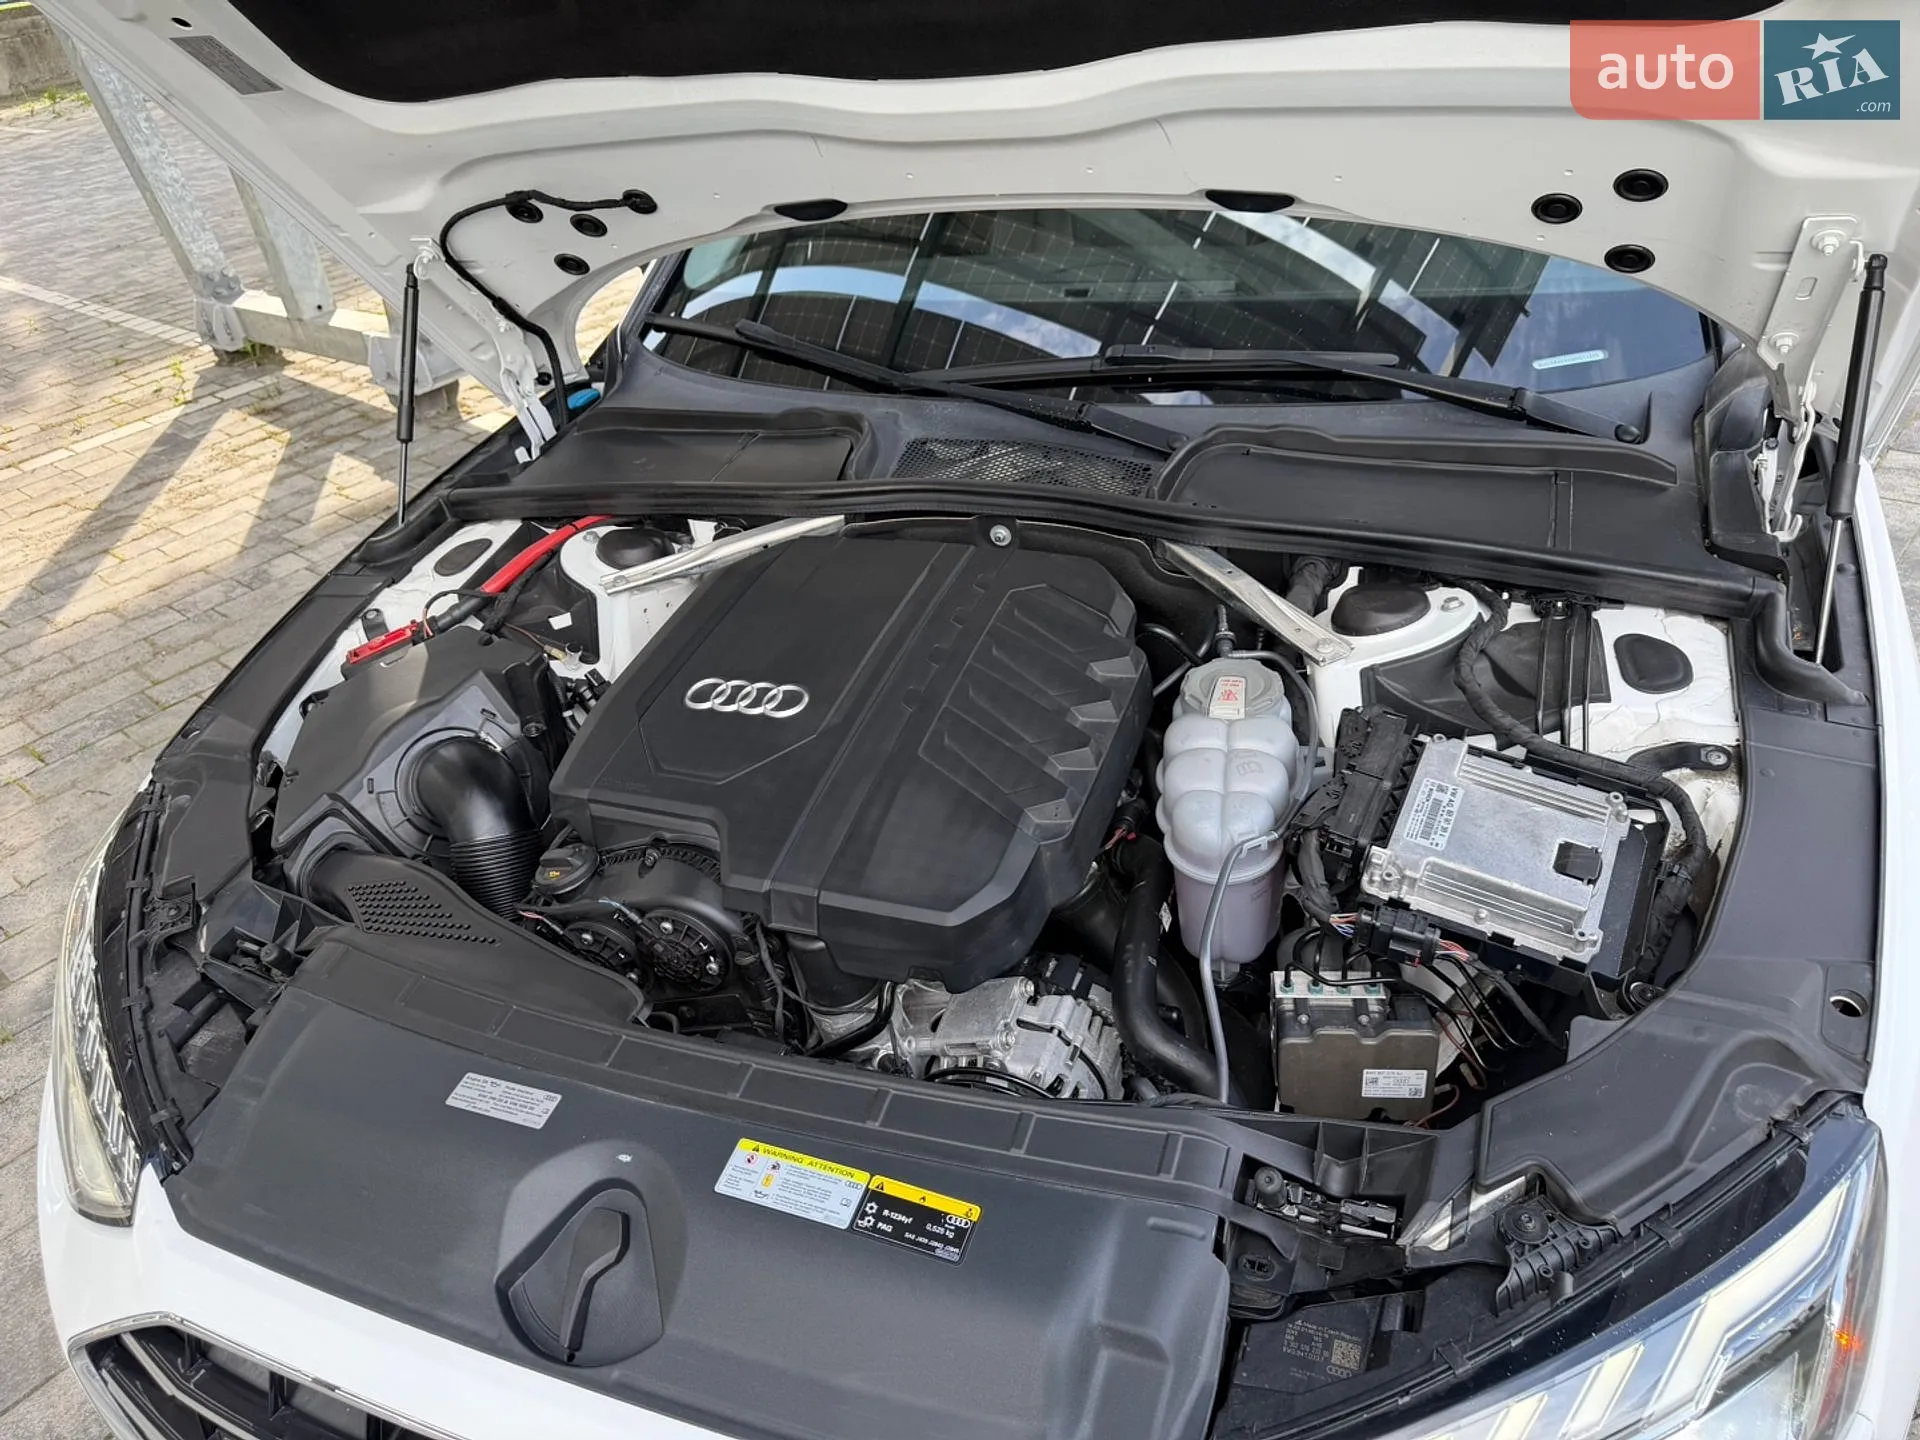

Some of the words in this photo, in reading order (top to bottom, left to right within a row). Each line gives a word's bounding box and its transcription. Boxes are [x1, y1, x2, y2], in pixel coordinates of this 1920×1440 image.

[762, 1147, 804, 1164] WARNING
[807, 1160, 856, 1179] ATTENTION
[876, 1222, 893, 1233] PAG
[946, 1229, 955, 1239] kg
